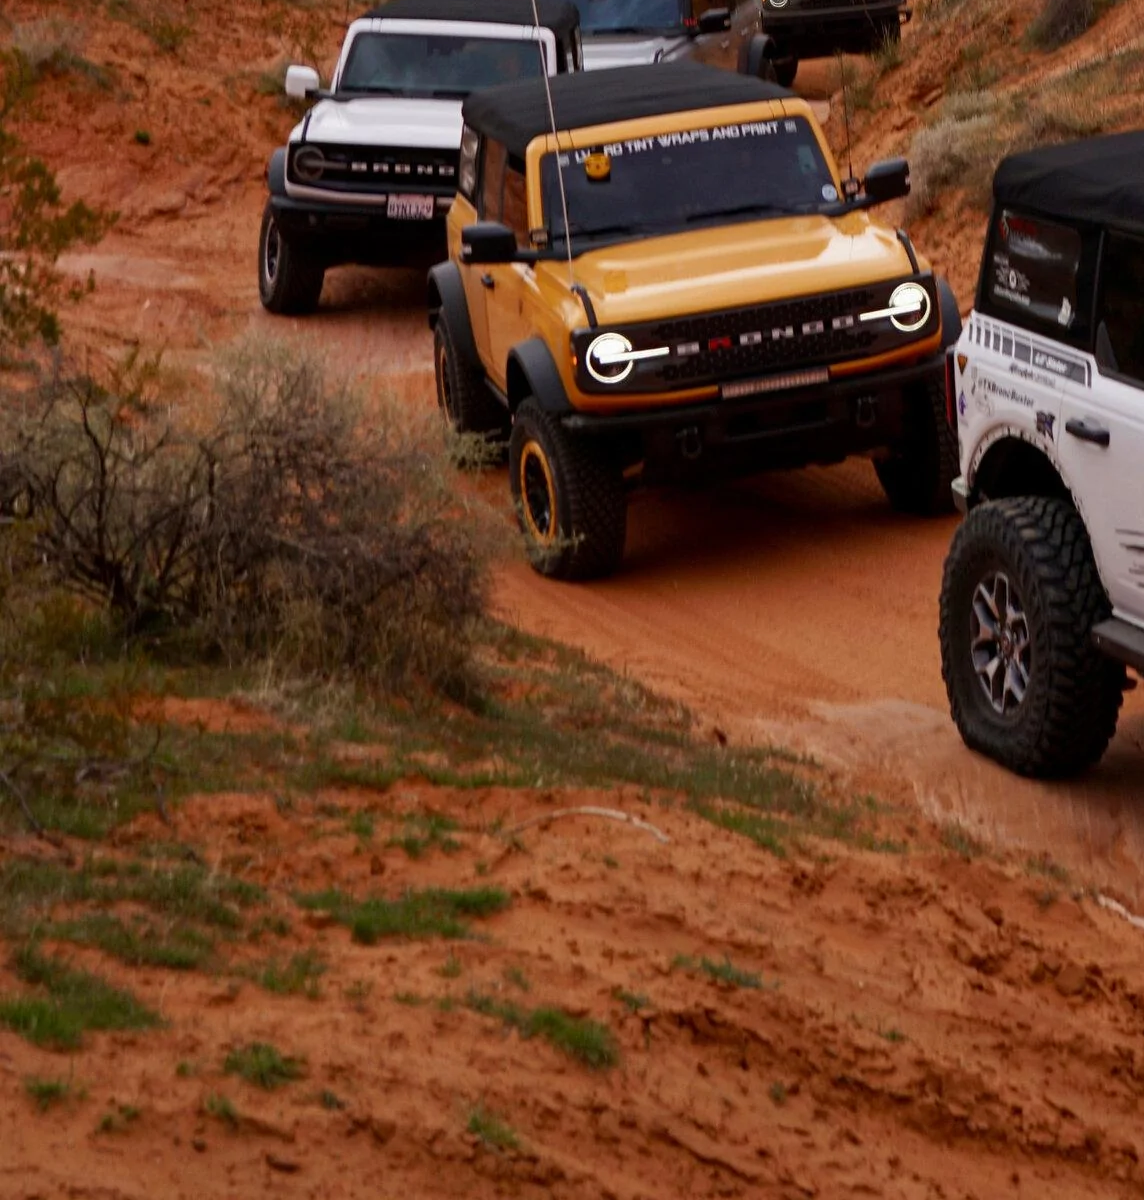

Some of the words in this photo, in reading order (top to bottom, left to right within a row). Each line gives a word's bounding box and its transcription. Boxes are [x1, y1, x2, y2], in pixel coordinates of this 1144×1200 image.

[625, 138, 654, 154] TINT
[657, 131, 711, 149] WRAPS
[712, 126, 741, 141] AND
[742, 121, 779, 138] PRINT
[676, 315, 855, 356] BRONCO
